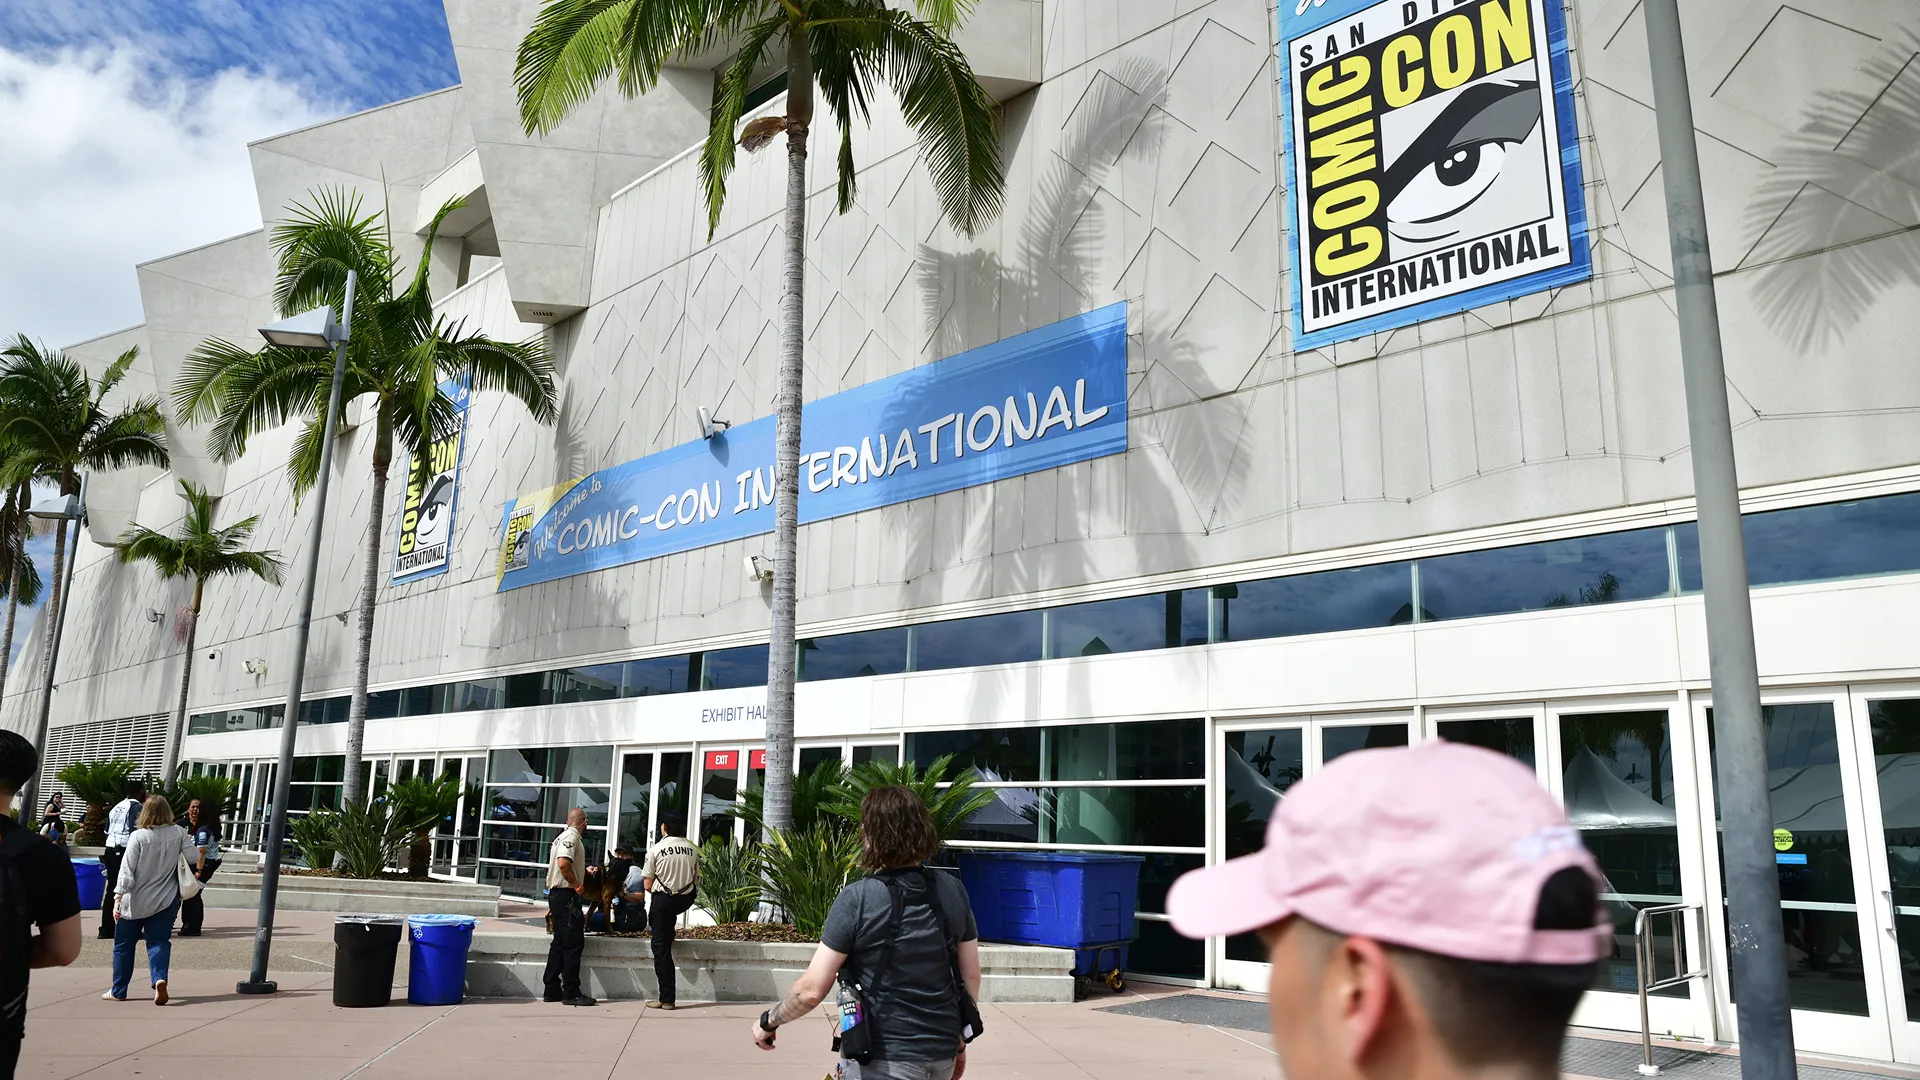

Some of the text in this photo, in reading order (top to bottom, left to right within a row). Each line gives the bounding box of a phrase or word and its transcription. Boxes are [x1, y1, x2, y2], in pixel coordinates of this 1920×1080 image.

[1300, 22, 1365, 68] SAN
[1381, 0, 1533, 108] CON
[1305, 55, 1383, 277] COMIC
[1312, 224, 1559, 319] INTERNATIONAL
[516, 514, 532, 531] CON
[534, 475, 602, 560] Welcome to
[557, 480, 722, 555] COMIC-CON
[396, 546, 445, 572] INTERNATIONAL
[506, 519, 517, 562] COMIC
[701, 705, 767, 723] EXHIBIT HAL
[715, 754, 729, 765] EXIT
[674, 846, 694, 856] UNIT
